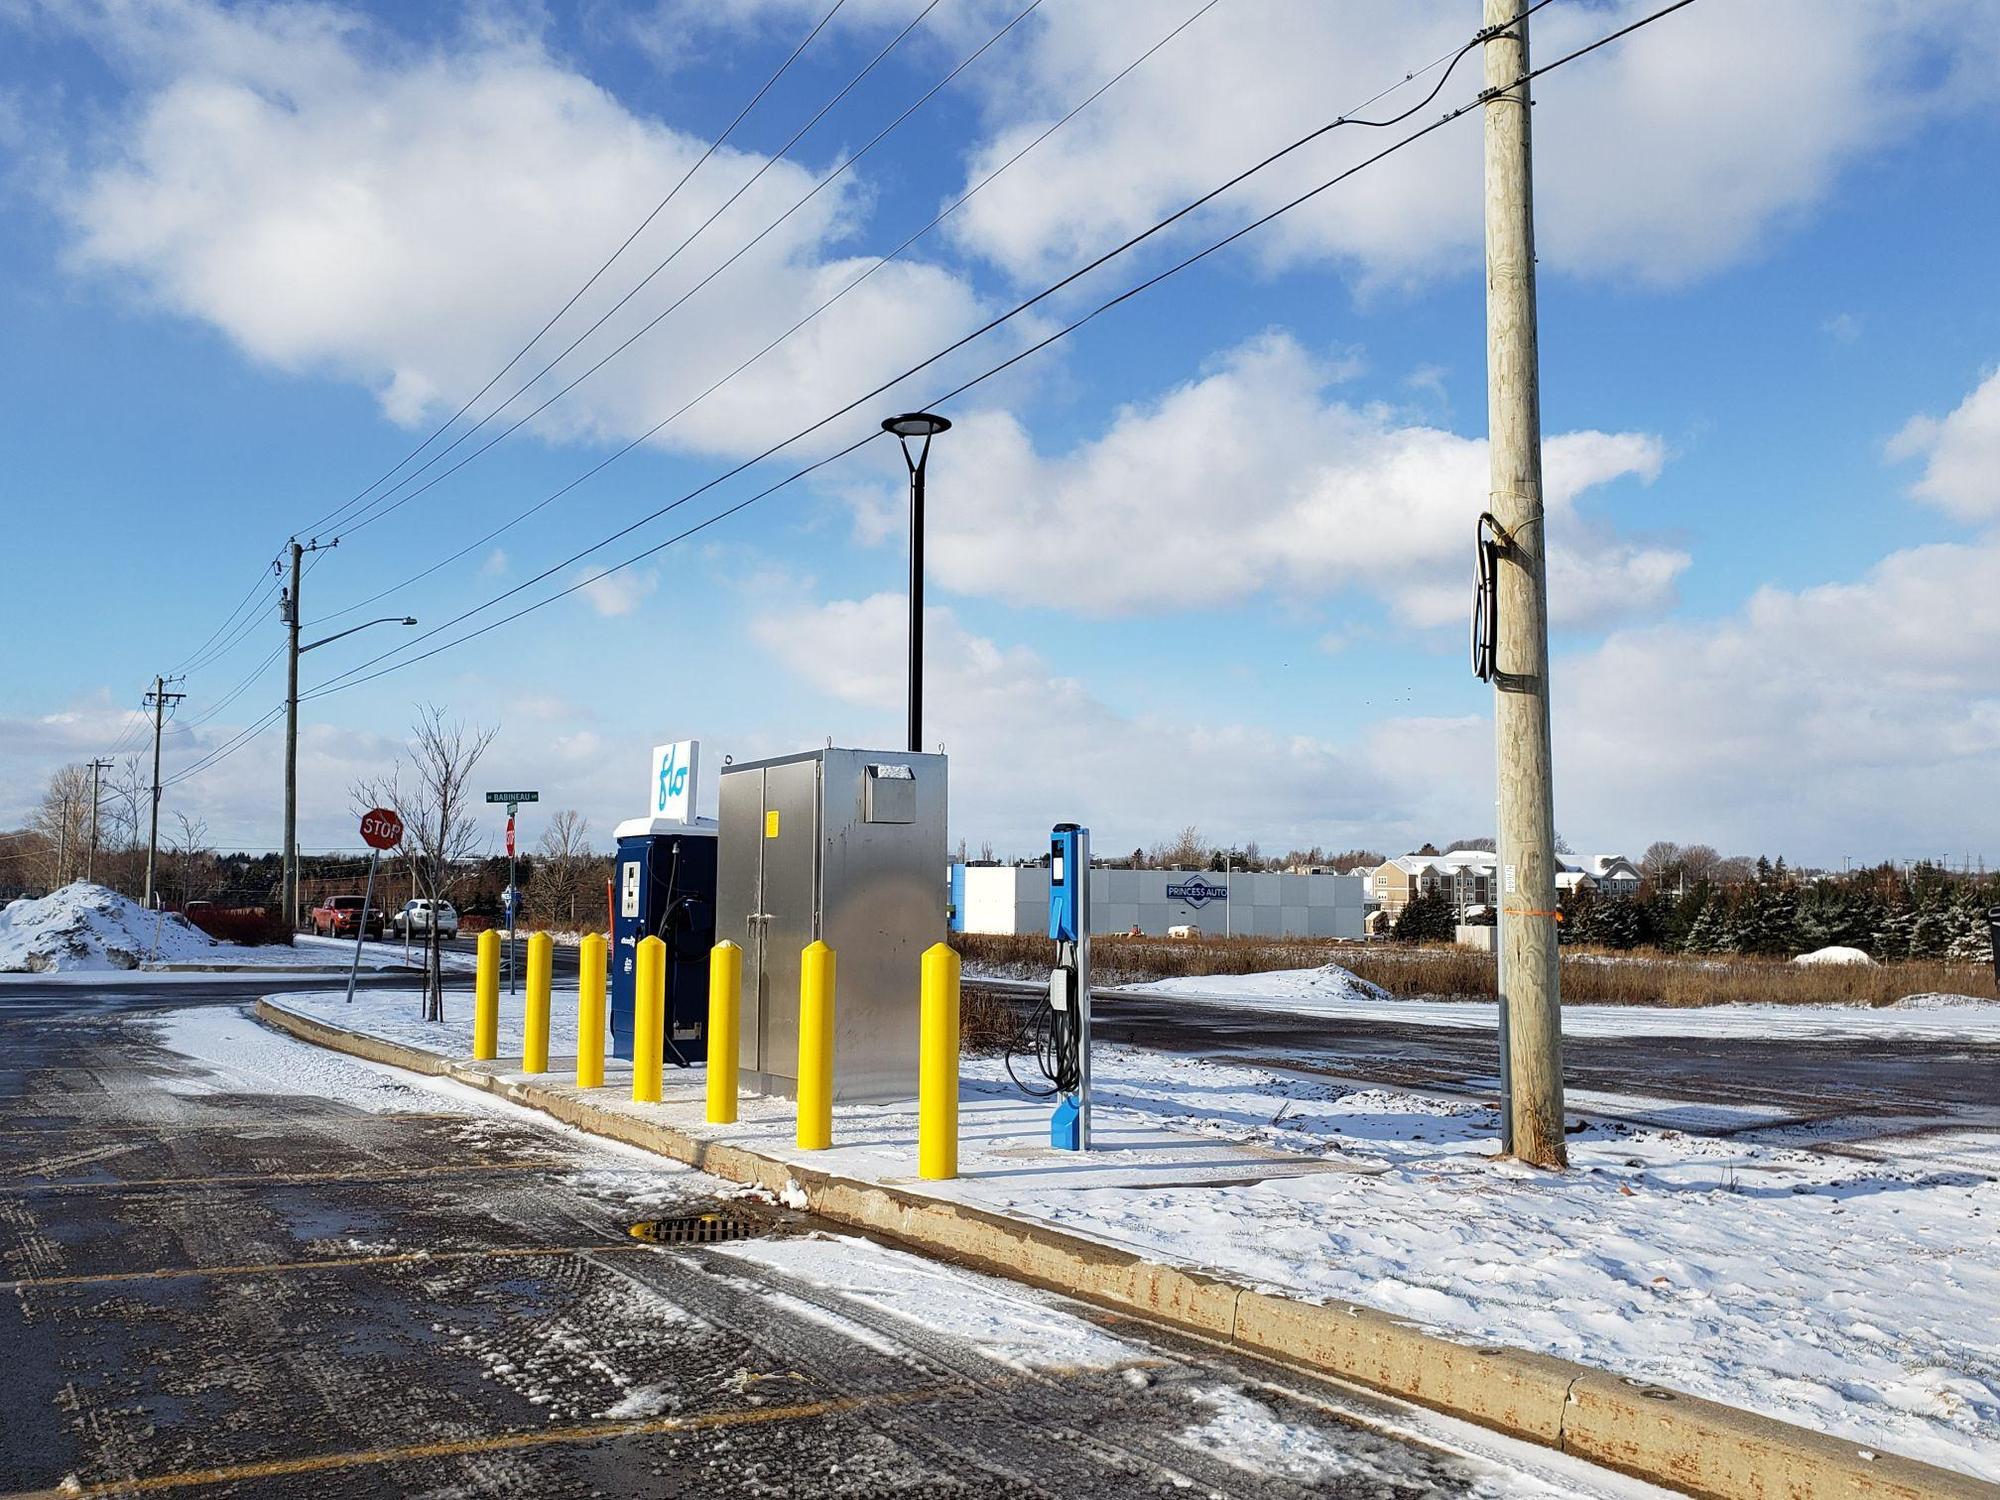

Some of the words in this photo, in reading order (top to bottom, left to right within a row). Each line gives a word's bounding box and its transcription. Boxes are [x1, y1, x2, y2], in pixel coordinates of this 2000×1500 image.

[659, 744, 688, 811] flo
[493, 793, 530, 801] BABINEAU
[363, 818, 401, 839] STOP
[1168, 887, 1206, 896] PRINCESS
[1206, 888, 1227, 897] AUTO
